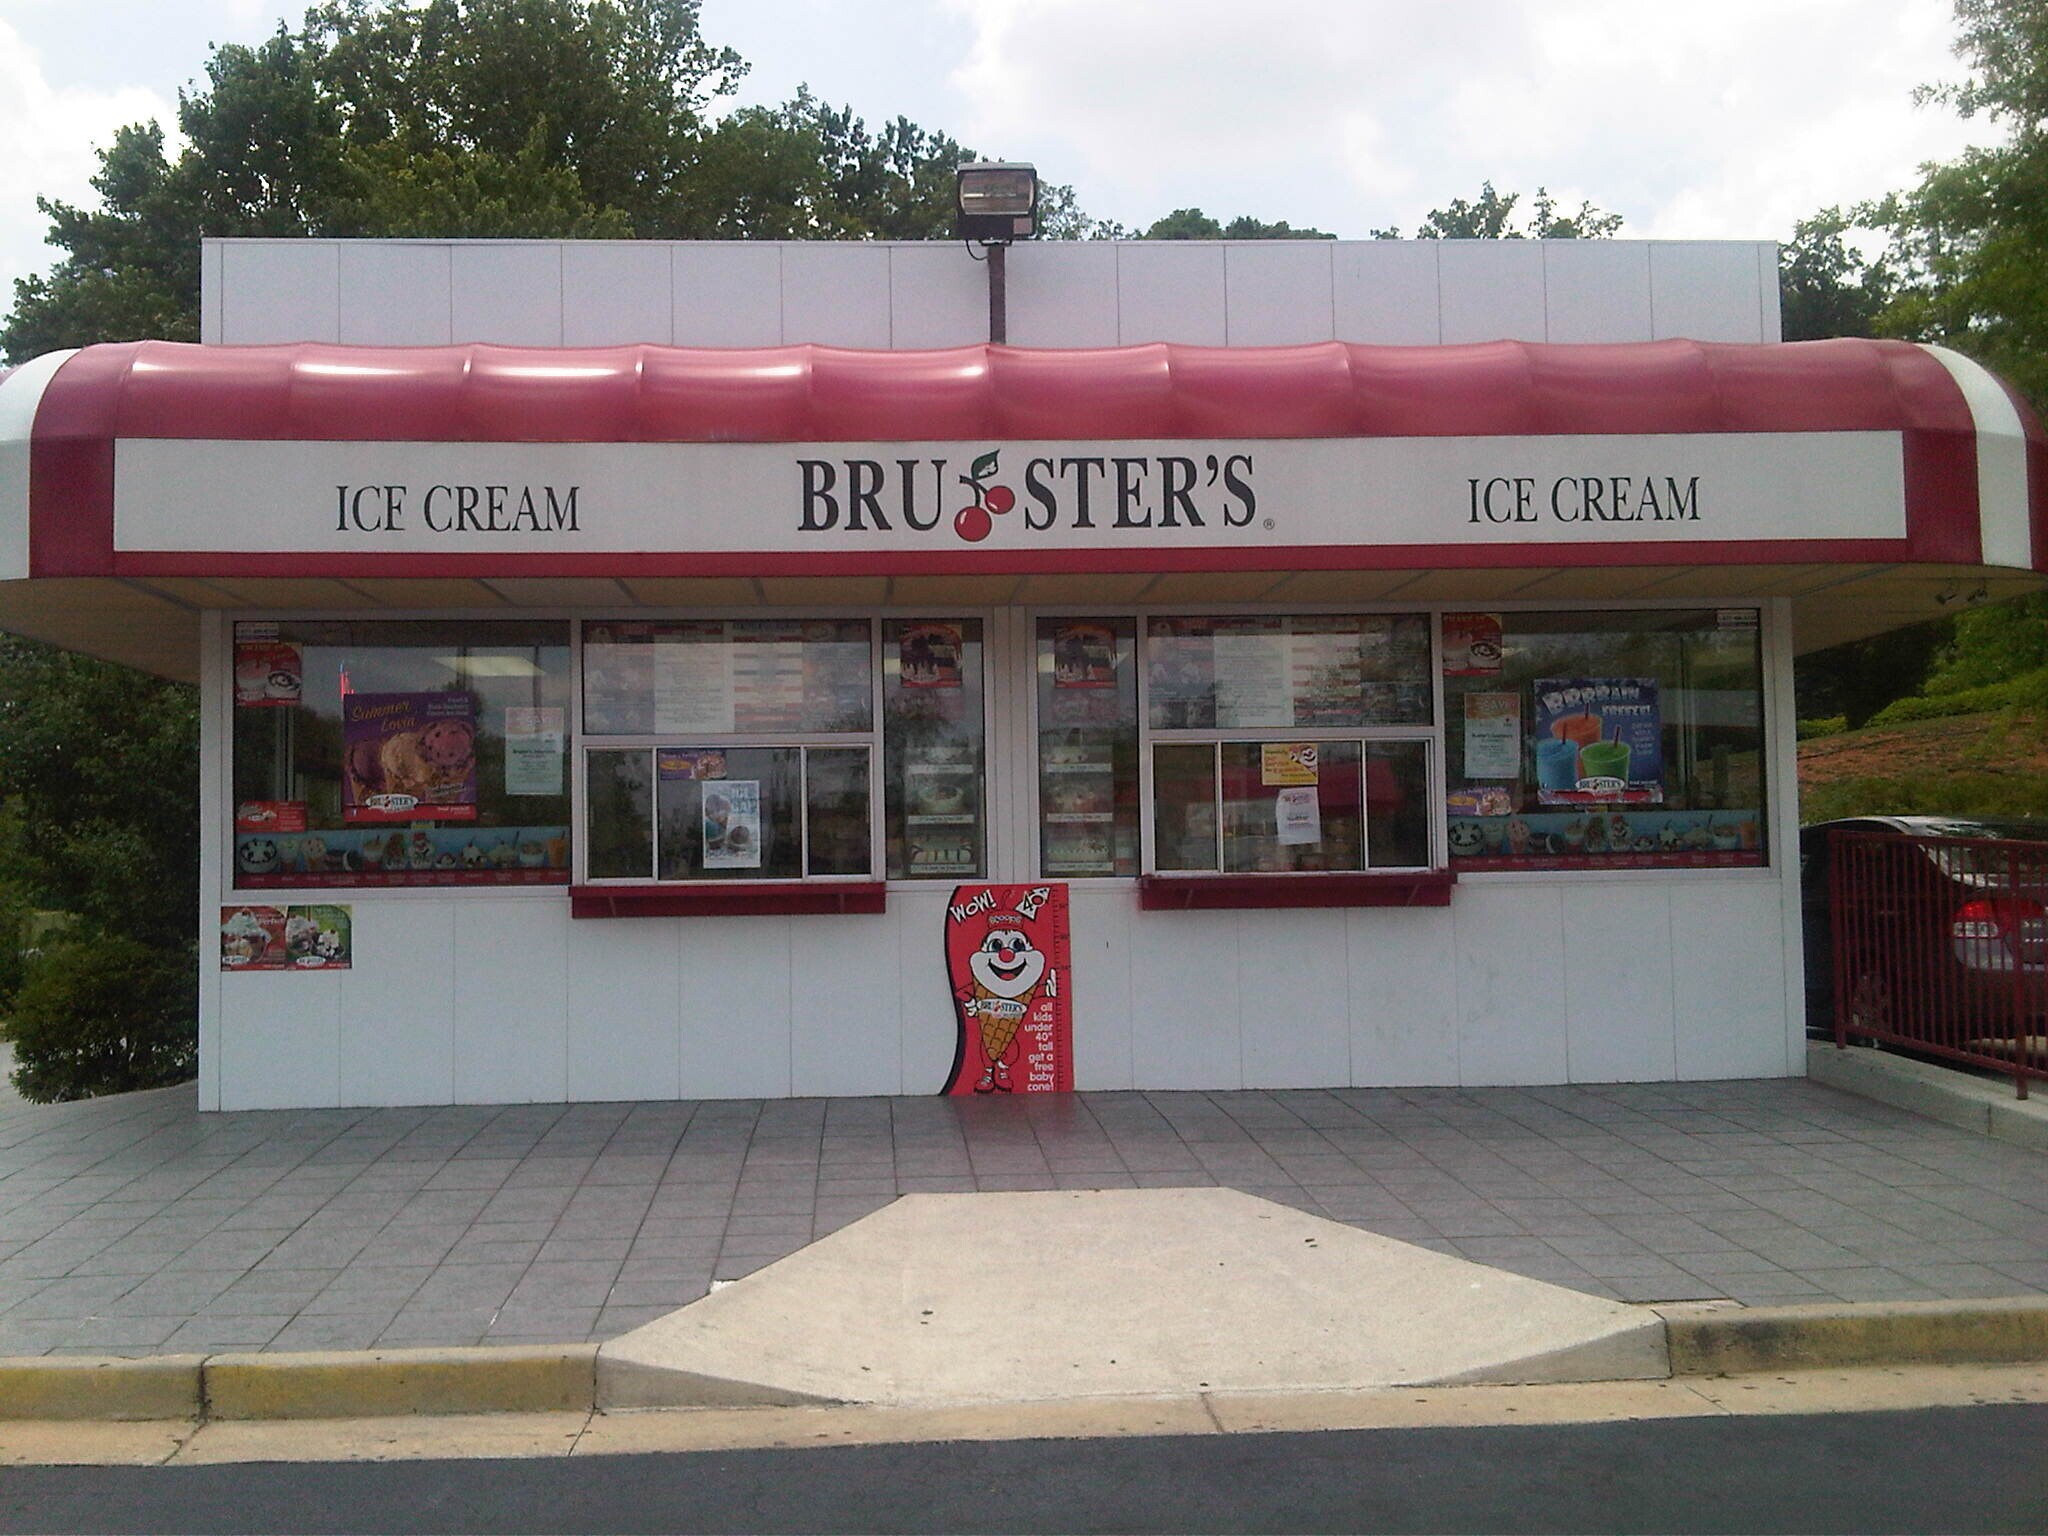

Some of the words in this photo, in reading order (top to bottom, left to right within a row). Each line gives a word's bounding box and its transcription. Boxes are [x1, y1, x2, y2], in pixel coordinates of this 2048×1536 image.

[1467, 477, 1539, 524] ICE
[1550, 475, 1701, 523] CREAM
[335, 484, 408, 532] ICE
[423, 484, 582, 533] CREAM
[1040, 1002, 1054, 1012] all
[1033, 1011, 1053, 1022] kids
[1024, 1022, 1054, 1032] under
[1038, 1041, 1054, 1052] tall
[1028, 1053, 1045, 1065] get
[1046, 1053, 1054, 1062] a
[1034, 1062, 1054, 1072] free
[1029, 1071, 1055, 1083] baby
